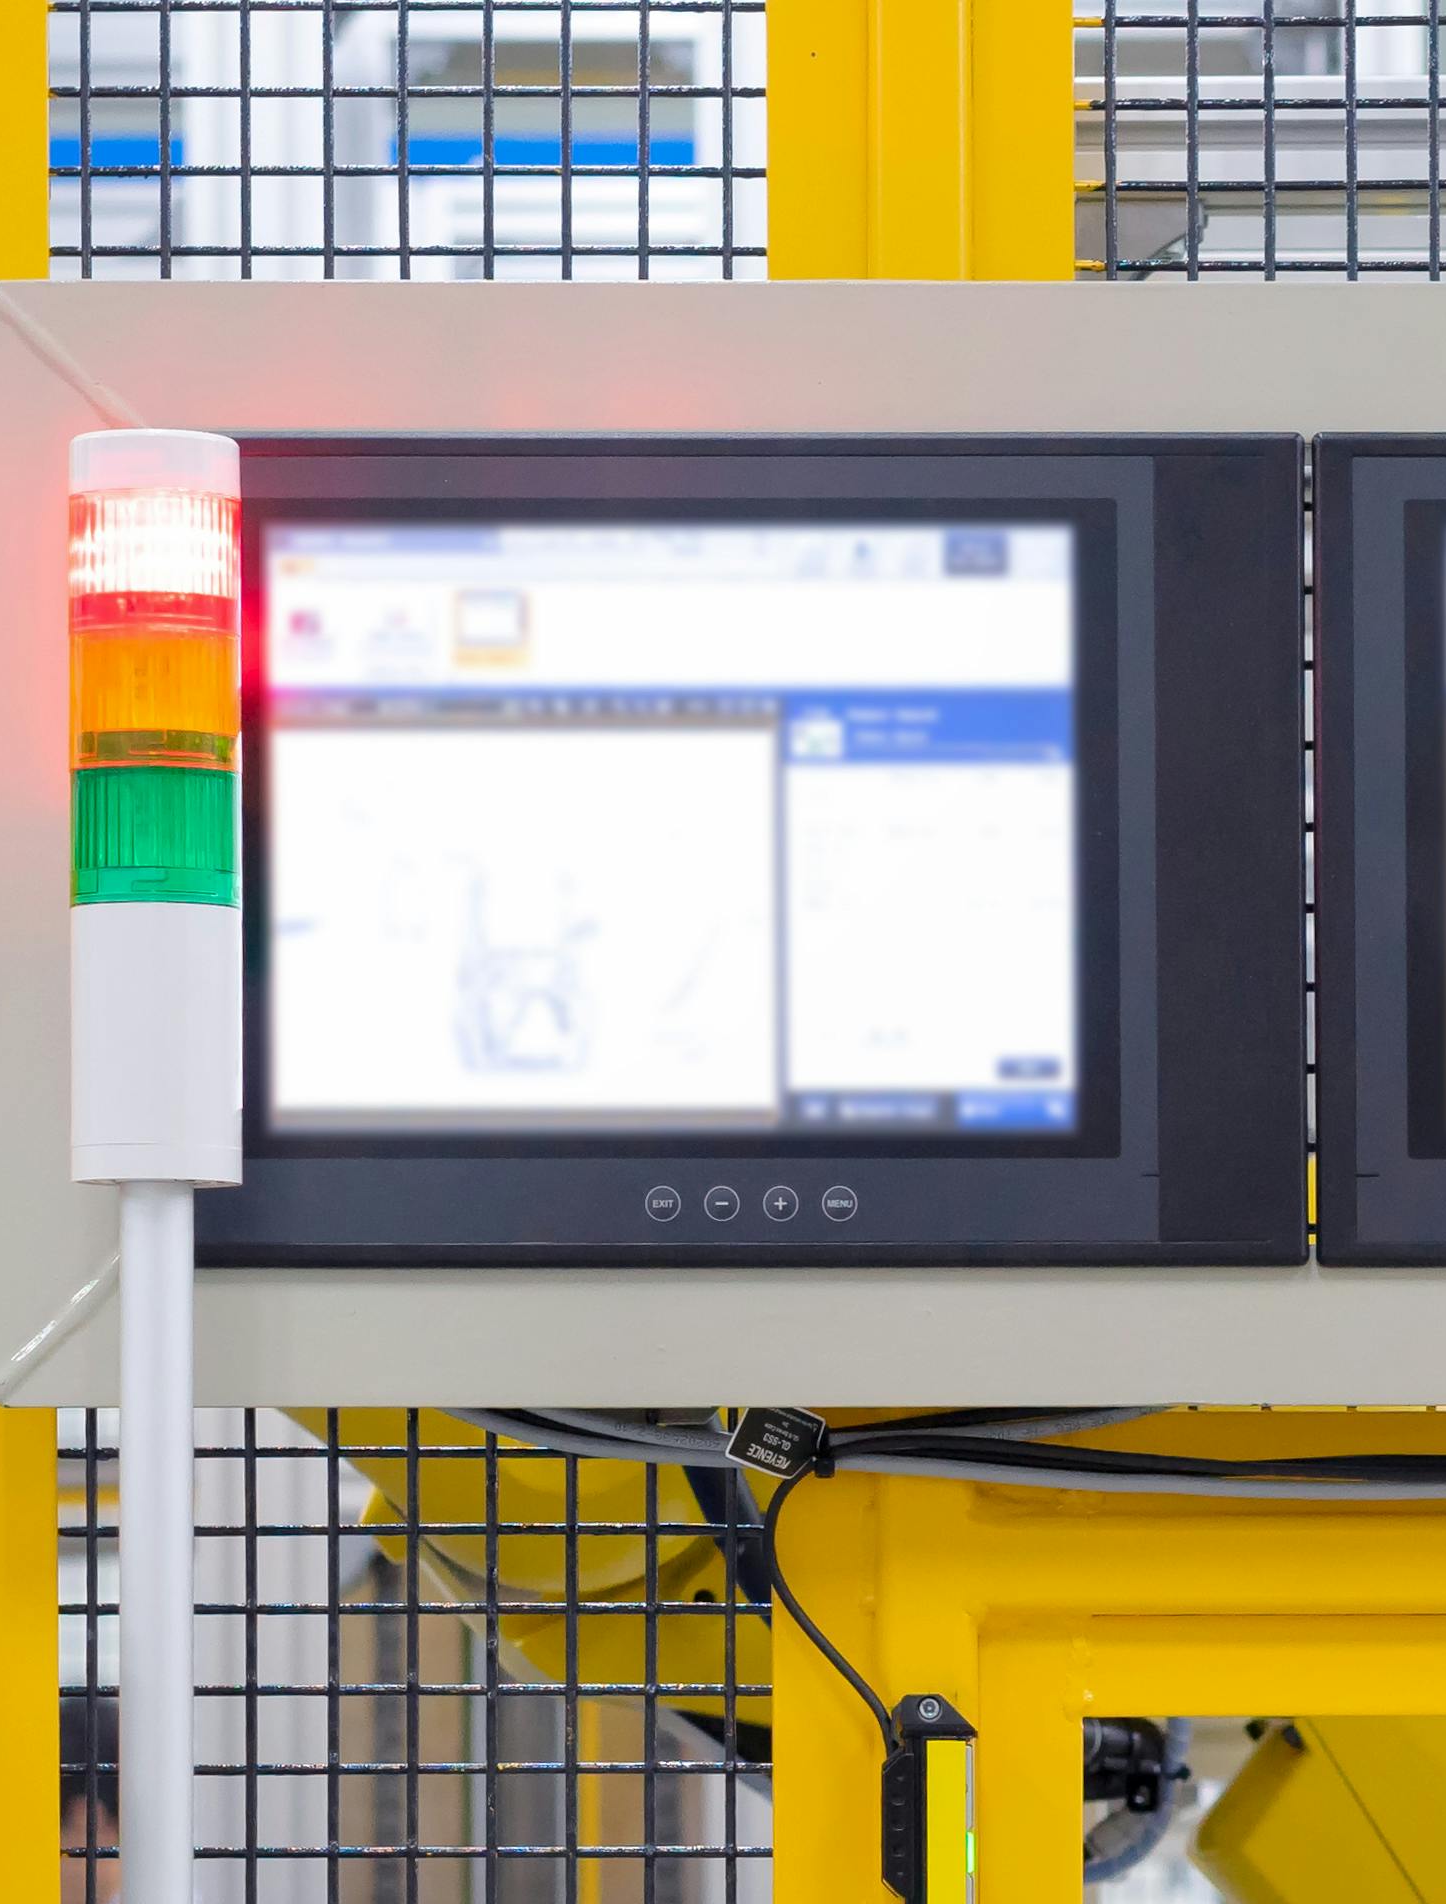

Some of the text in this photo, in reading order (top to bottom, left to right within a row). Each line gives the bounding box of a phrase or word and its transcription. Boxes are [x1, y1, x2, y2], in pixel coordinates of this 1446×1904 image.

[652, 1199, 674, 1208] EXIT
[827, 1199, 853, 1208] MENU
[762, 1432, 792, 1451] GL-SS3
[745, 1443, 792, 1470] KEYENCE
